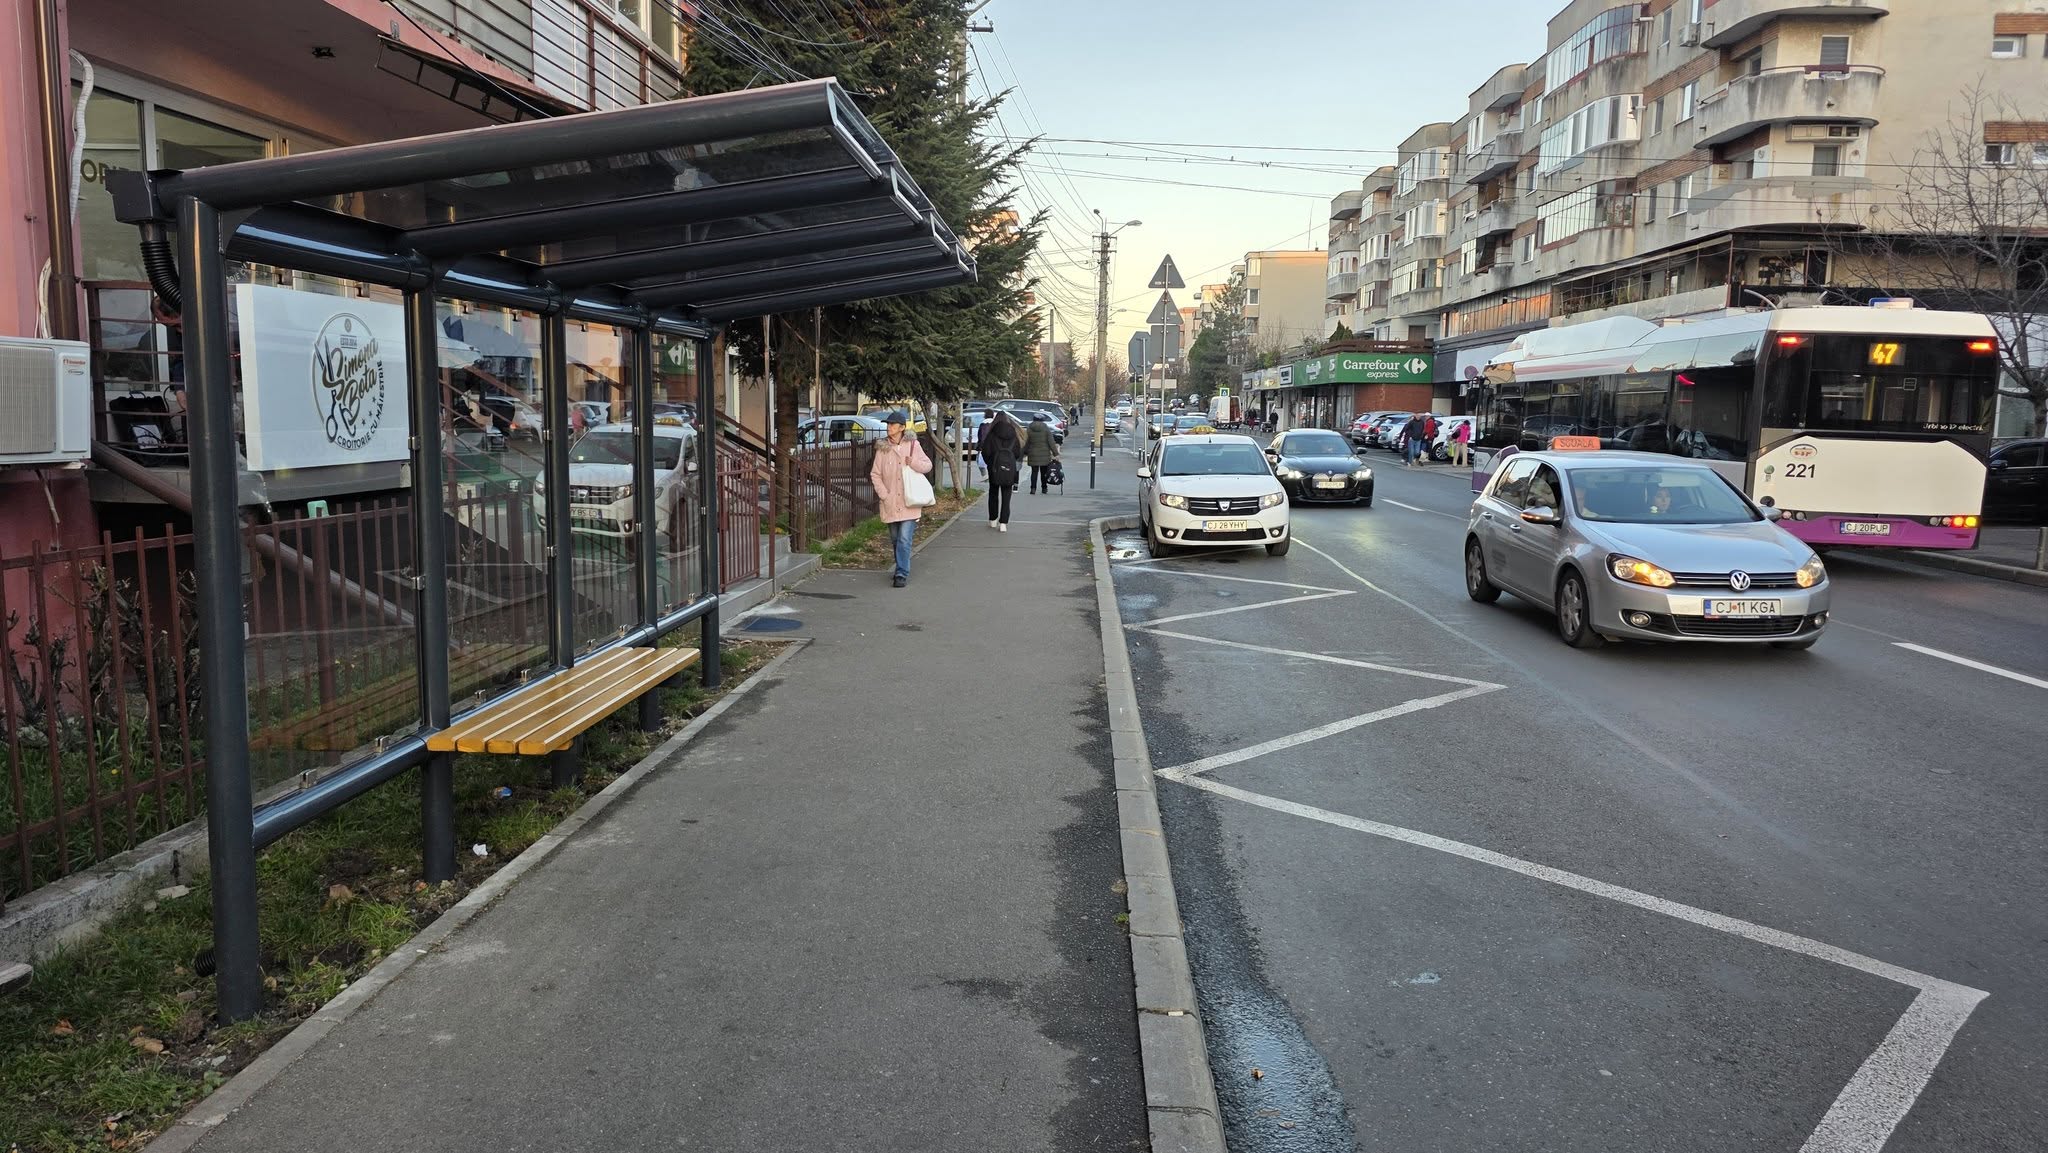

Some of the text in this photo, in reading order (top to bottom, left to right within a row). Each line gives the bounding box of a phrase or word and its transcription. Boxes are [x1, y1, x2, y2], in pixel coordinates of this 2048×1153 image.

[1873, 343, 1898, 365] 47
[322, 338, 379, 401] Simona
[1343, 360, 1400, 370] Carrefour
[1366, 371, 1400, 379] express
[341, 365, 377, 426] Bota
[337, 434, 371, 449] CROITORIE
[1785, 463, 1816, 478] 221
[1229, 521, 1244, 529] YHY
[1716, 602, 1776, 613] CJ 11 KGA
